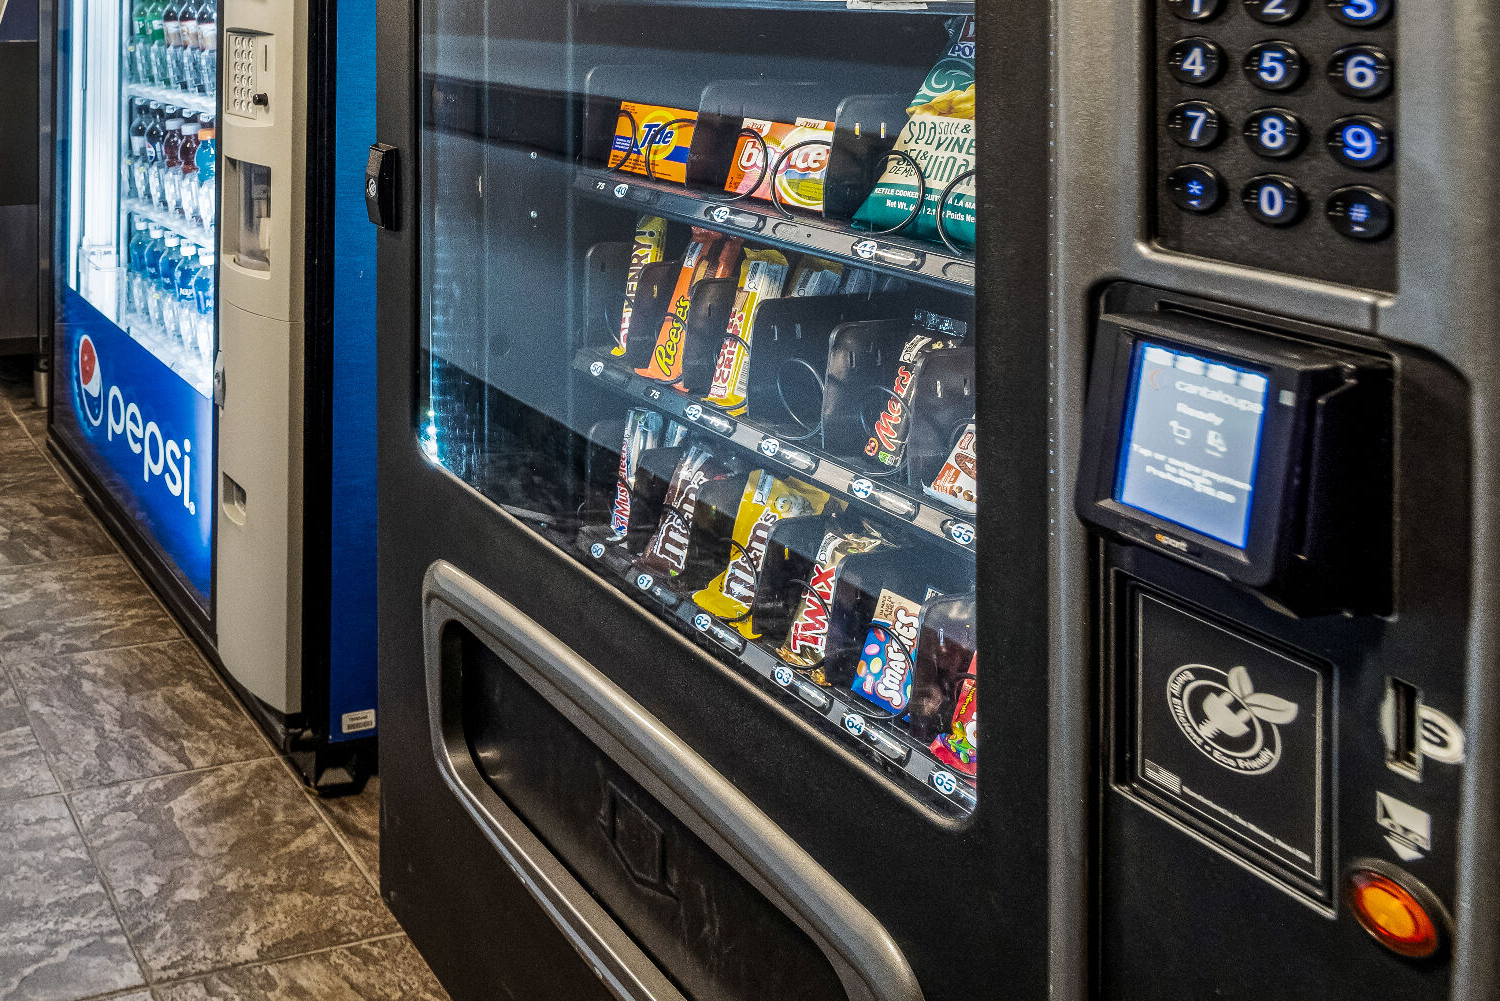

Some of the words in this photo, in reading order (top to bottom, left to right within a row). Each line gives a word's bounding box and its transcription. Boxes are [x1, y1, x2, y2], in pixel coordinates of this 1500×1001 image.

[1182, 47, 1205, 76] 4
[1258, 51, 1285, 83] 5
[1344, 55, 1377, 89] 6
[1184, 111, 1207, 141] 7
[1259, 116, 1286, 149] 8
[1342, 125, 1377, 160] 9
[596, 181, 606, 190] 75
[894, 189, 919, 199] COOKED
[954, 198, 963, 207] LA
[1257, 185, 1285, 218] 0
[714, 209, 729, 220] 42
[885, 199, 897, 209] Net
[897, 201, 908, 211] Wt.
[945, 209, 965, 222] Poids
[591, 363, 603, 374] 50
[649, 389, 661, 399] 75
[686, 406, 701, 418] 52
[108, 385, 192, 509] pepsi
[762, 440, 778, 454] 53
[853, 481, 872, 496] 54
[952, 525, 975, 543] 55
[592, 545, 604, 557] 60
[637, 575, 652, 589] 61
[695, 615, 710, 630] 62
[775, 668, 792, 684] 63
[845, 716, 863, 733] 64
[1212, 748, 1238, 768] Eco
[935, 774, 955, 793] 65
